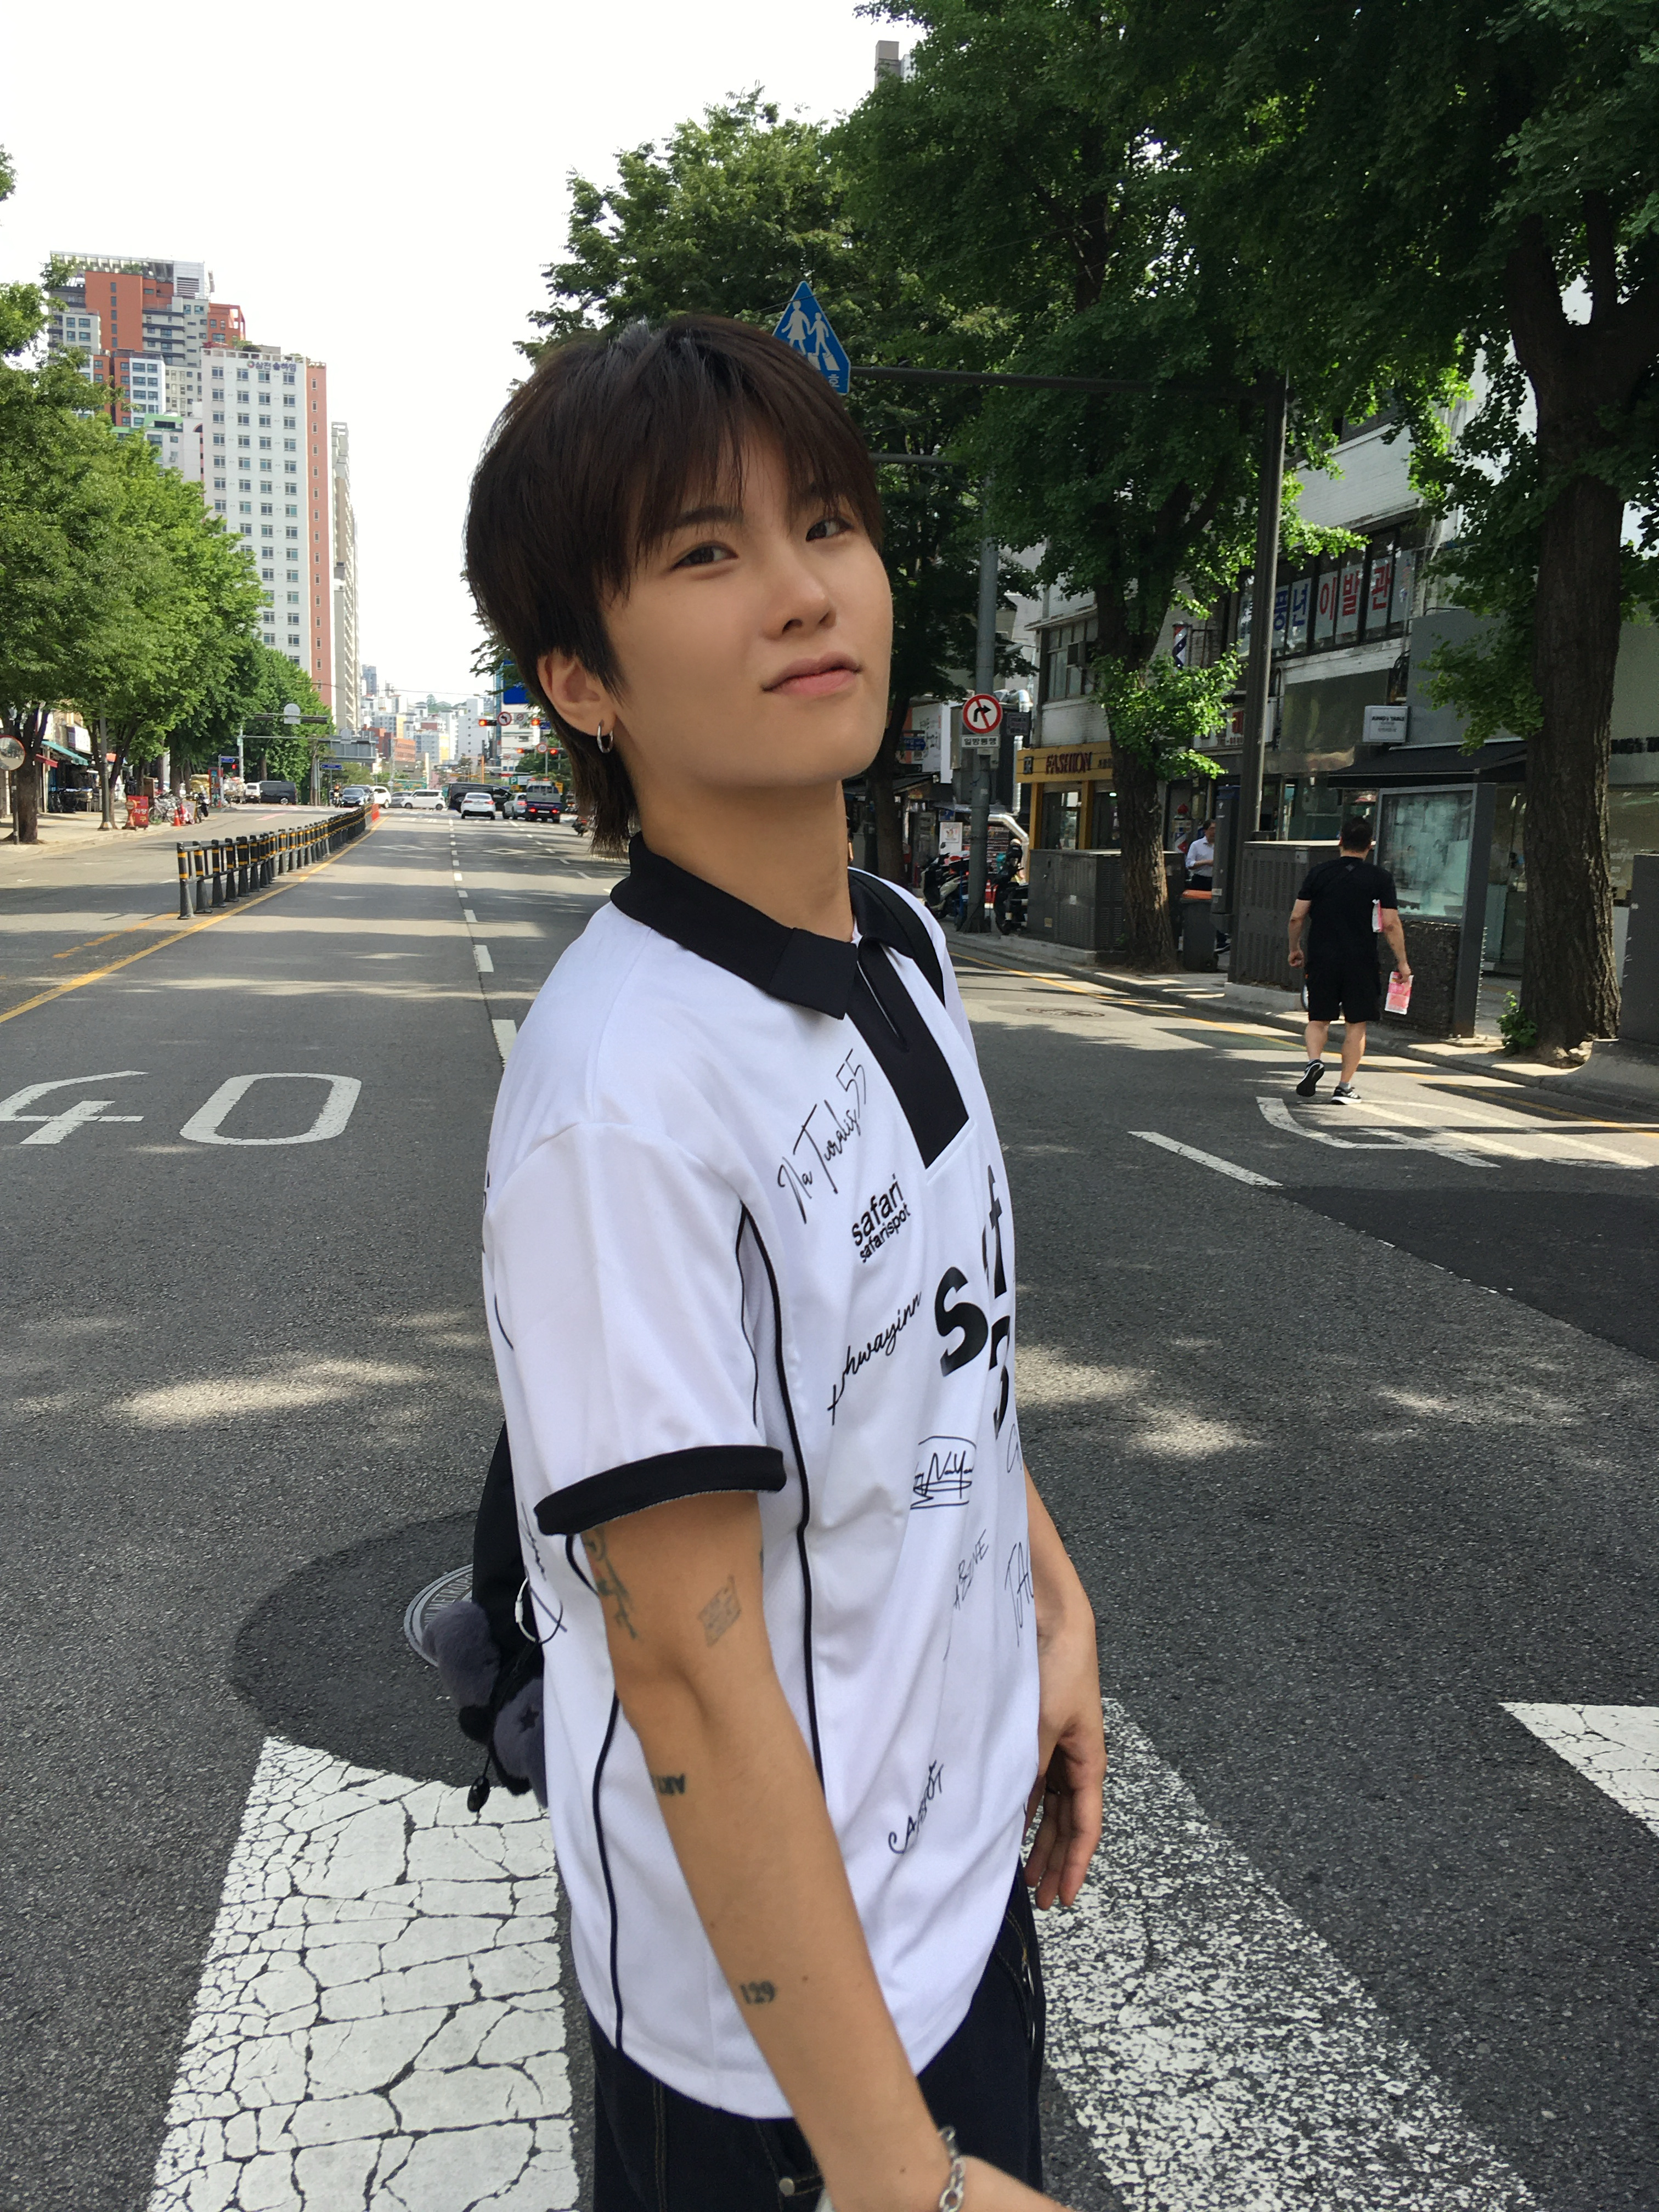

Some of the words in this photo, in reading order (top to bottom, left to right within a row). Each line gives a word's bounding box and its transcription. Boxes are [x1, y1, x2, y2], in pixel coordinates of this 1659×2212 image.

[1045, 752, 1092, 774] FASHION
[0, 1070, 362, 1145] 40
[851, 1173, 904, 1246] safari
[860, 1202, 911, 1263] safarispot
